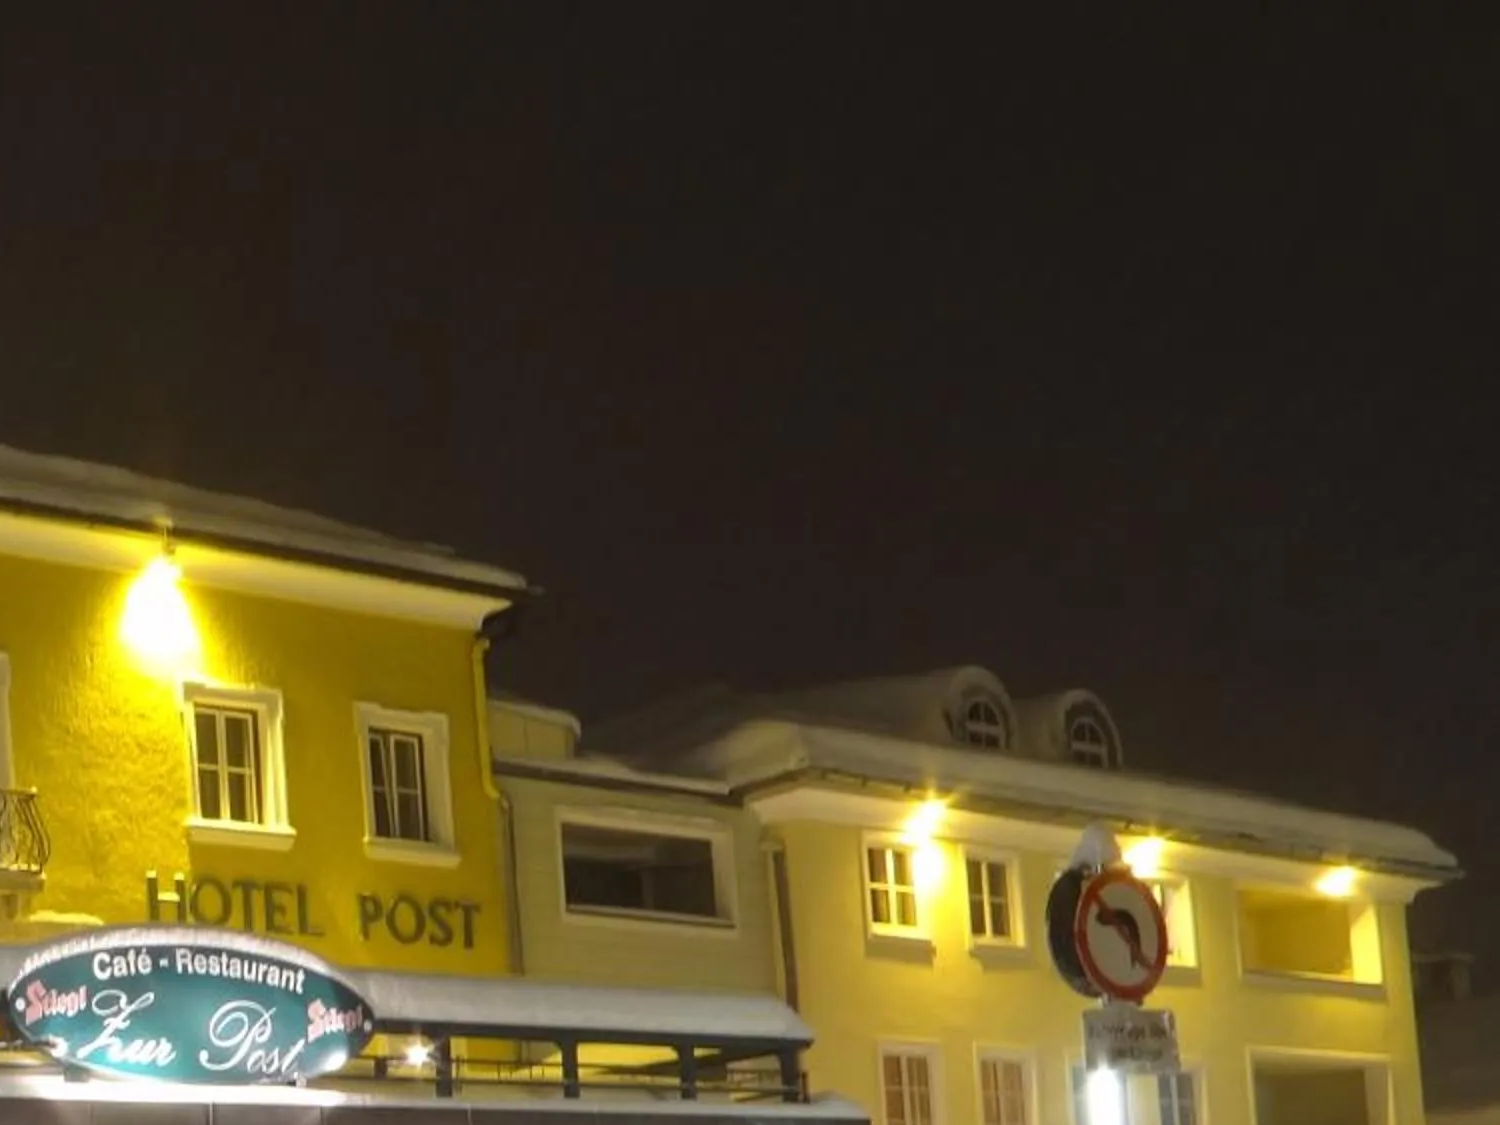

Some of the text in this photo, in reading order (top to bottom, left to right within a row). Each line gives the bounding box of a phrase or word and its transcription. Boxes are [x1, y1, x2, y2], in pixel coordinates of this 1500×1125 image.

[146, 871, 482, 950] HOTEL POST
[92, 947, 153, 981] Café
[175, 949, 306, 995] Restaurant
[77, 989, 306, 1074] Zur Post
